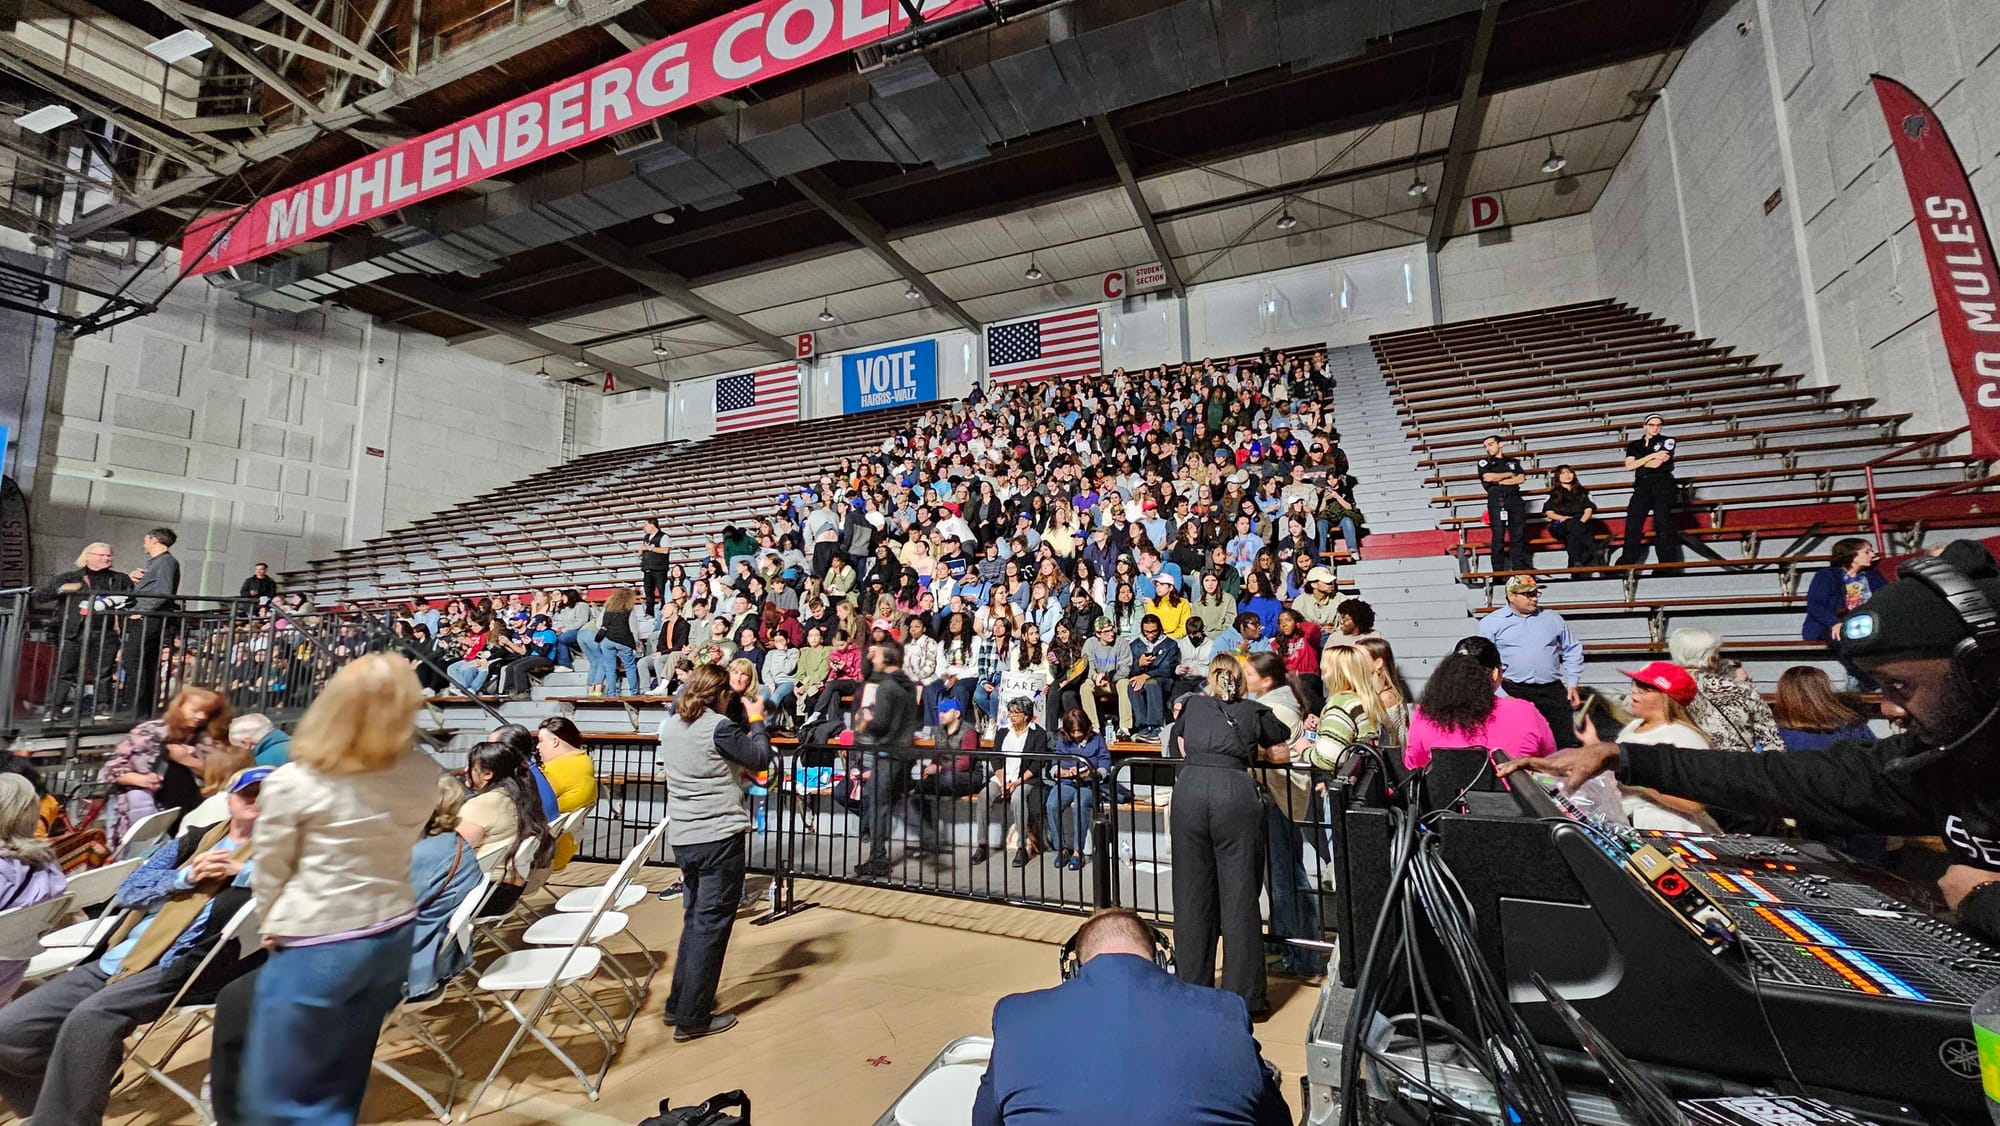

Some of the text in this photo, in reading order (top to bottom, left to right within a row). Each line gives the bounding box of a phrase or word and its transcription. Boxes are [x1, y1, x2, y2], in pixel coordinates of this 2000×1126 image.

[266, 42, 690, 246] MUHLENBERG
[1472, 196, 1499, 227] D
[1136, 265, 1163, 276] STUDENT
[1924, 196, 2000, 333] MULES
[1103, 272, 1123, 298] C
[1136, 274, 1164, 285] SECTION
[798, 333, 812, 356] B
[602, 371, 615, 392] A
[856, 350, 917, 395] VOTE
[861, 386, 917, 408] HARRIS-WALZ
